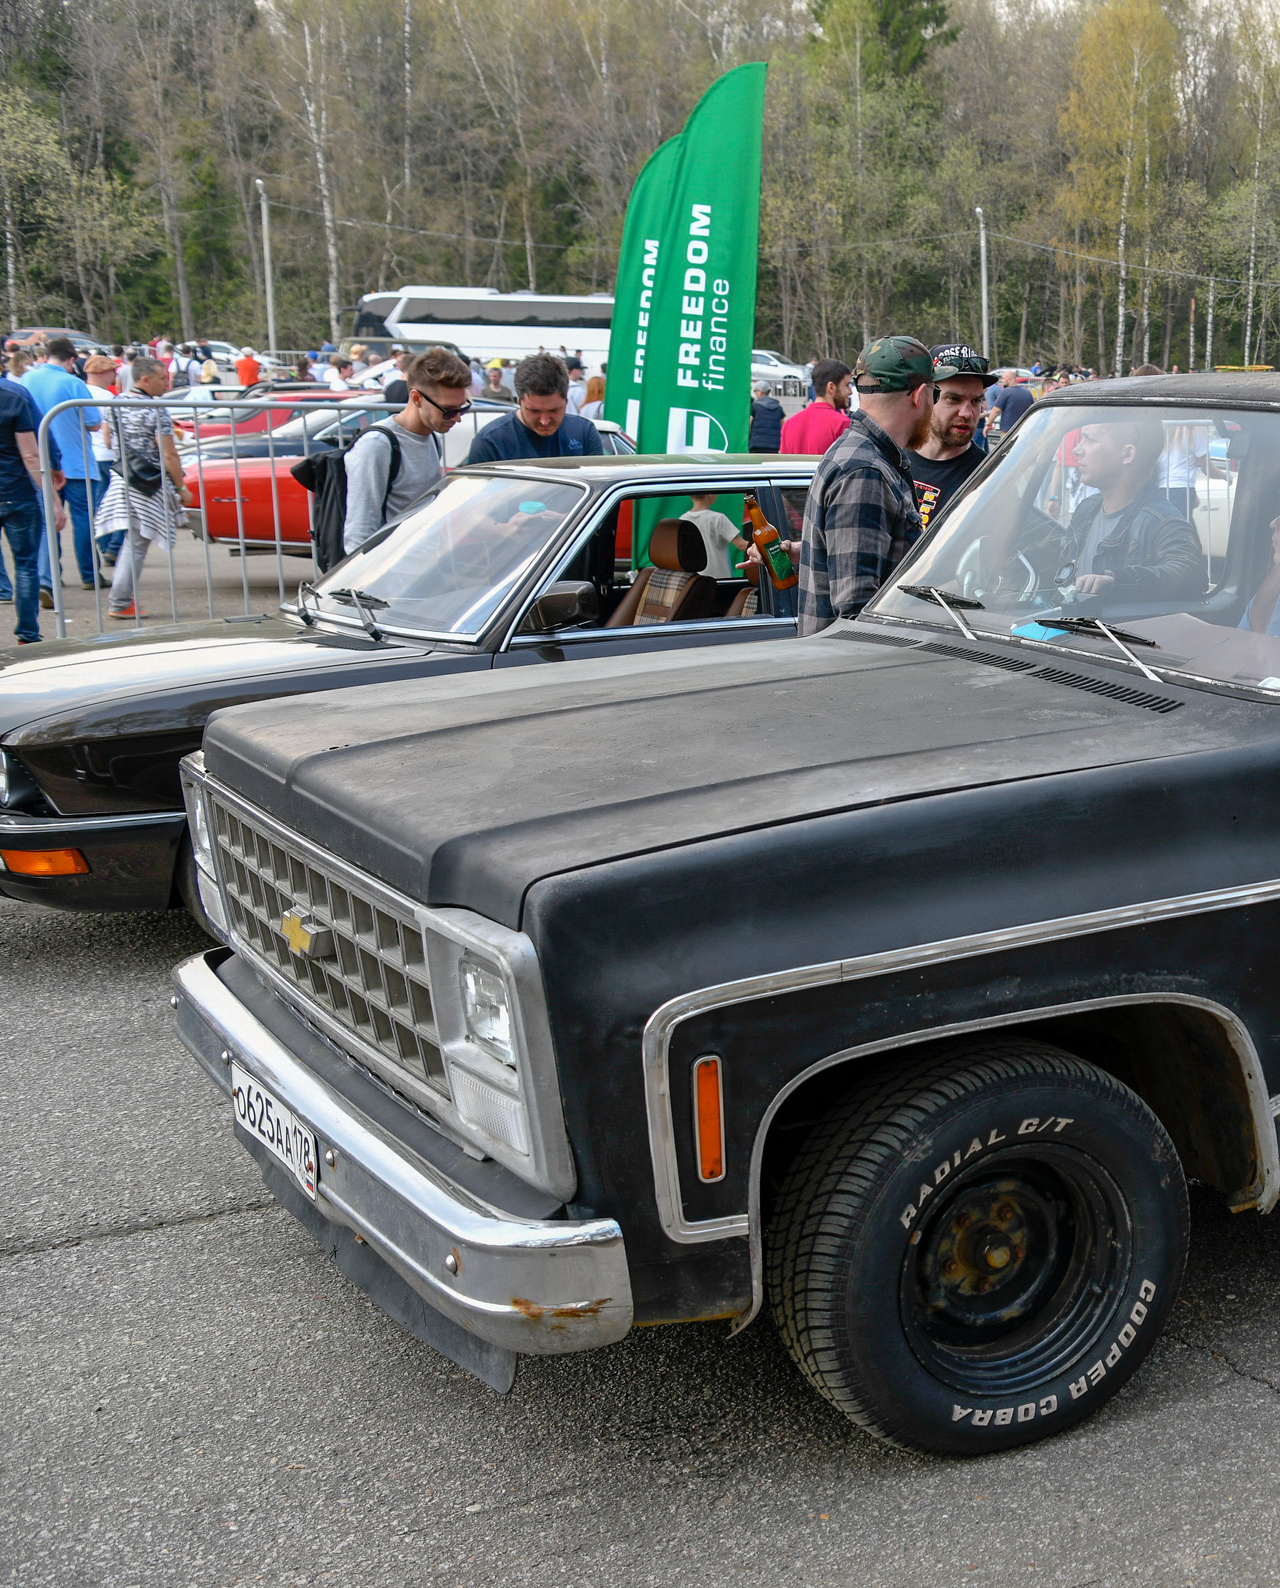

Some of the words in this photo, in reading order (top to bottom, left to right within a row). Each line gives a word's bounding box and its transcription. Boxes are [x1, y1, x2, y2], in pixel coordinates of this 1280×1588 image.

[677, 204, 712, 388] FREEDOM
[702, 278, 730, 391] finance
[900, 1127, 1006, 1230] RADIAL
[1017, 1116, 1075, 1136] G/T
[1068, 1278, 1157, 1400] COOPER
[951, 1393, 1059, 1427] COBRA
